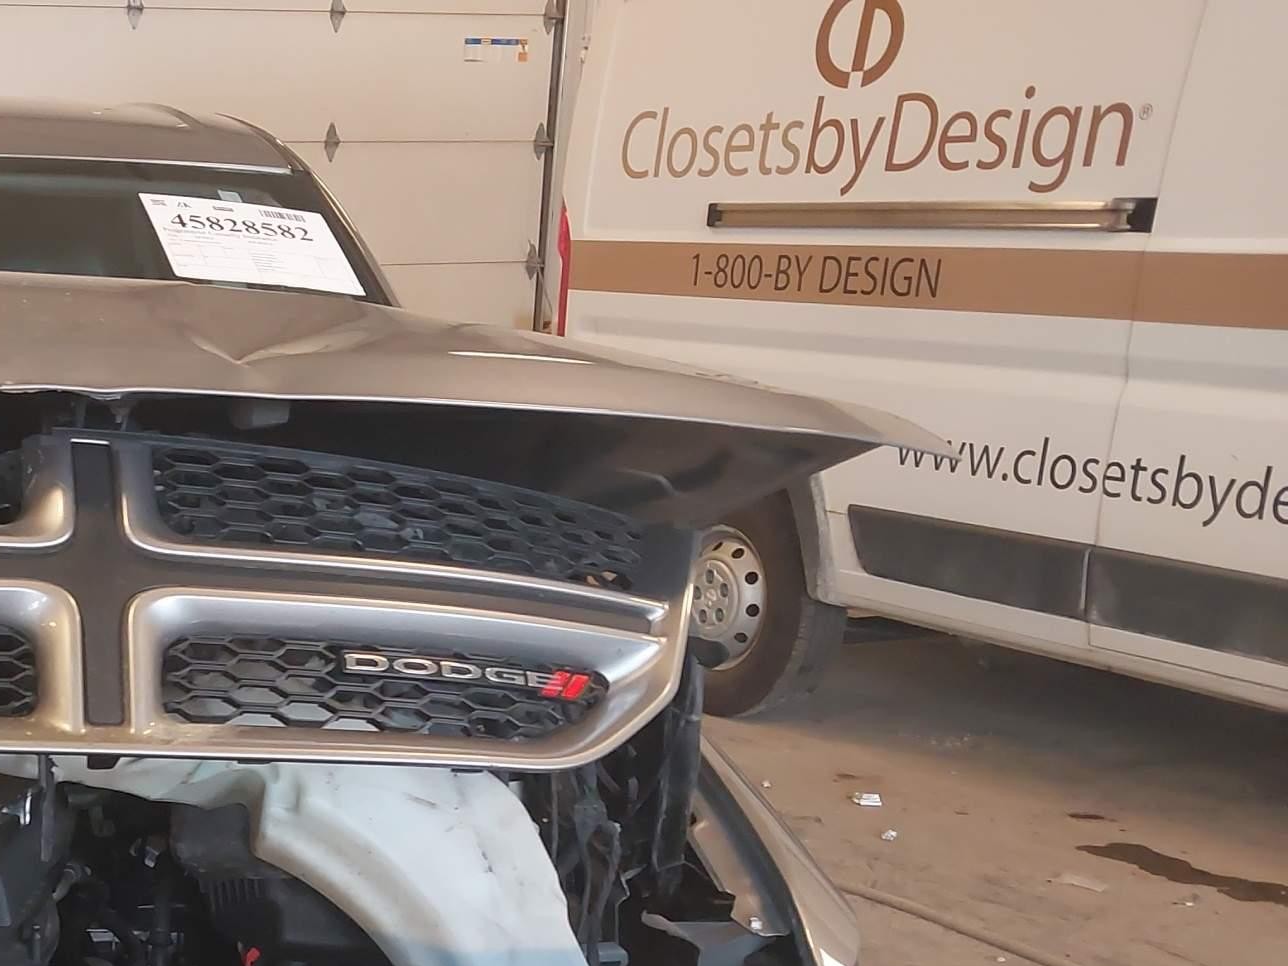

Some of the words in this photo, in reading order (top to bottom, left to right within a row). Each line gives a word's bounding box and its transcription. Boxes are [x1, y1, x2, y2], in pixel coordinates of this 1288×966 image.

[170, 213, 314, 242] 45828582
[691, 252, 811, 292] 1-800-BY
[818, 257, 942, 298] DESIGN
[344, 653, 562, 690] DODGE
